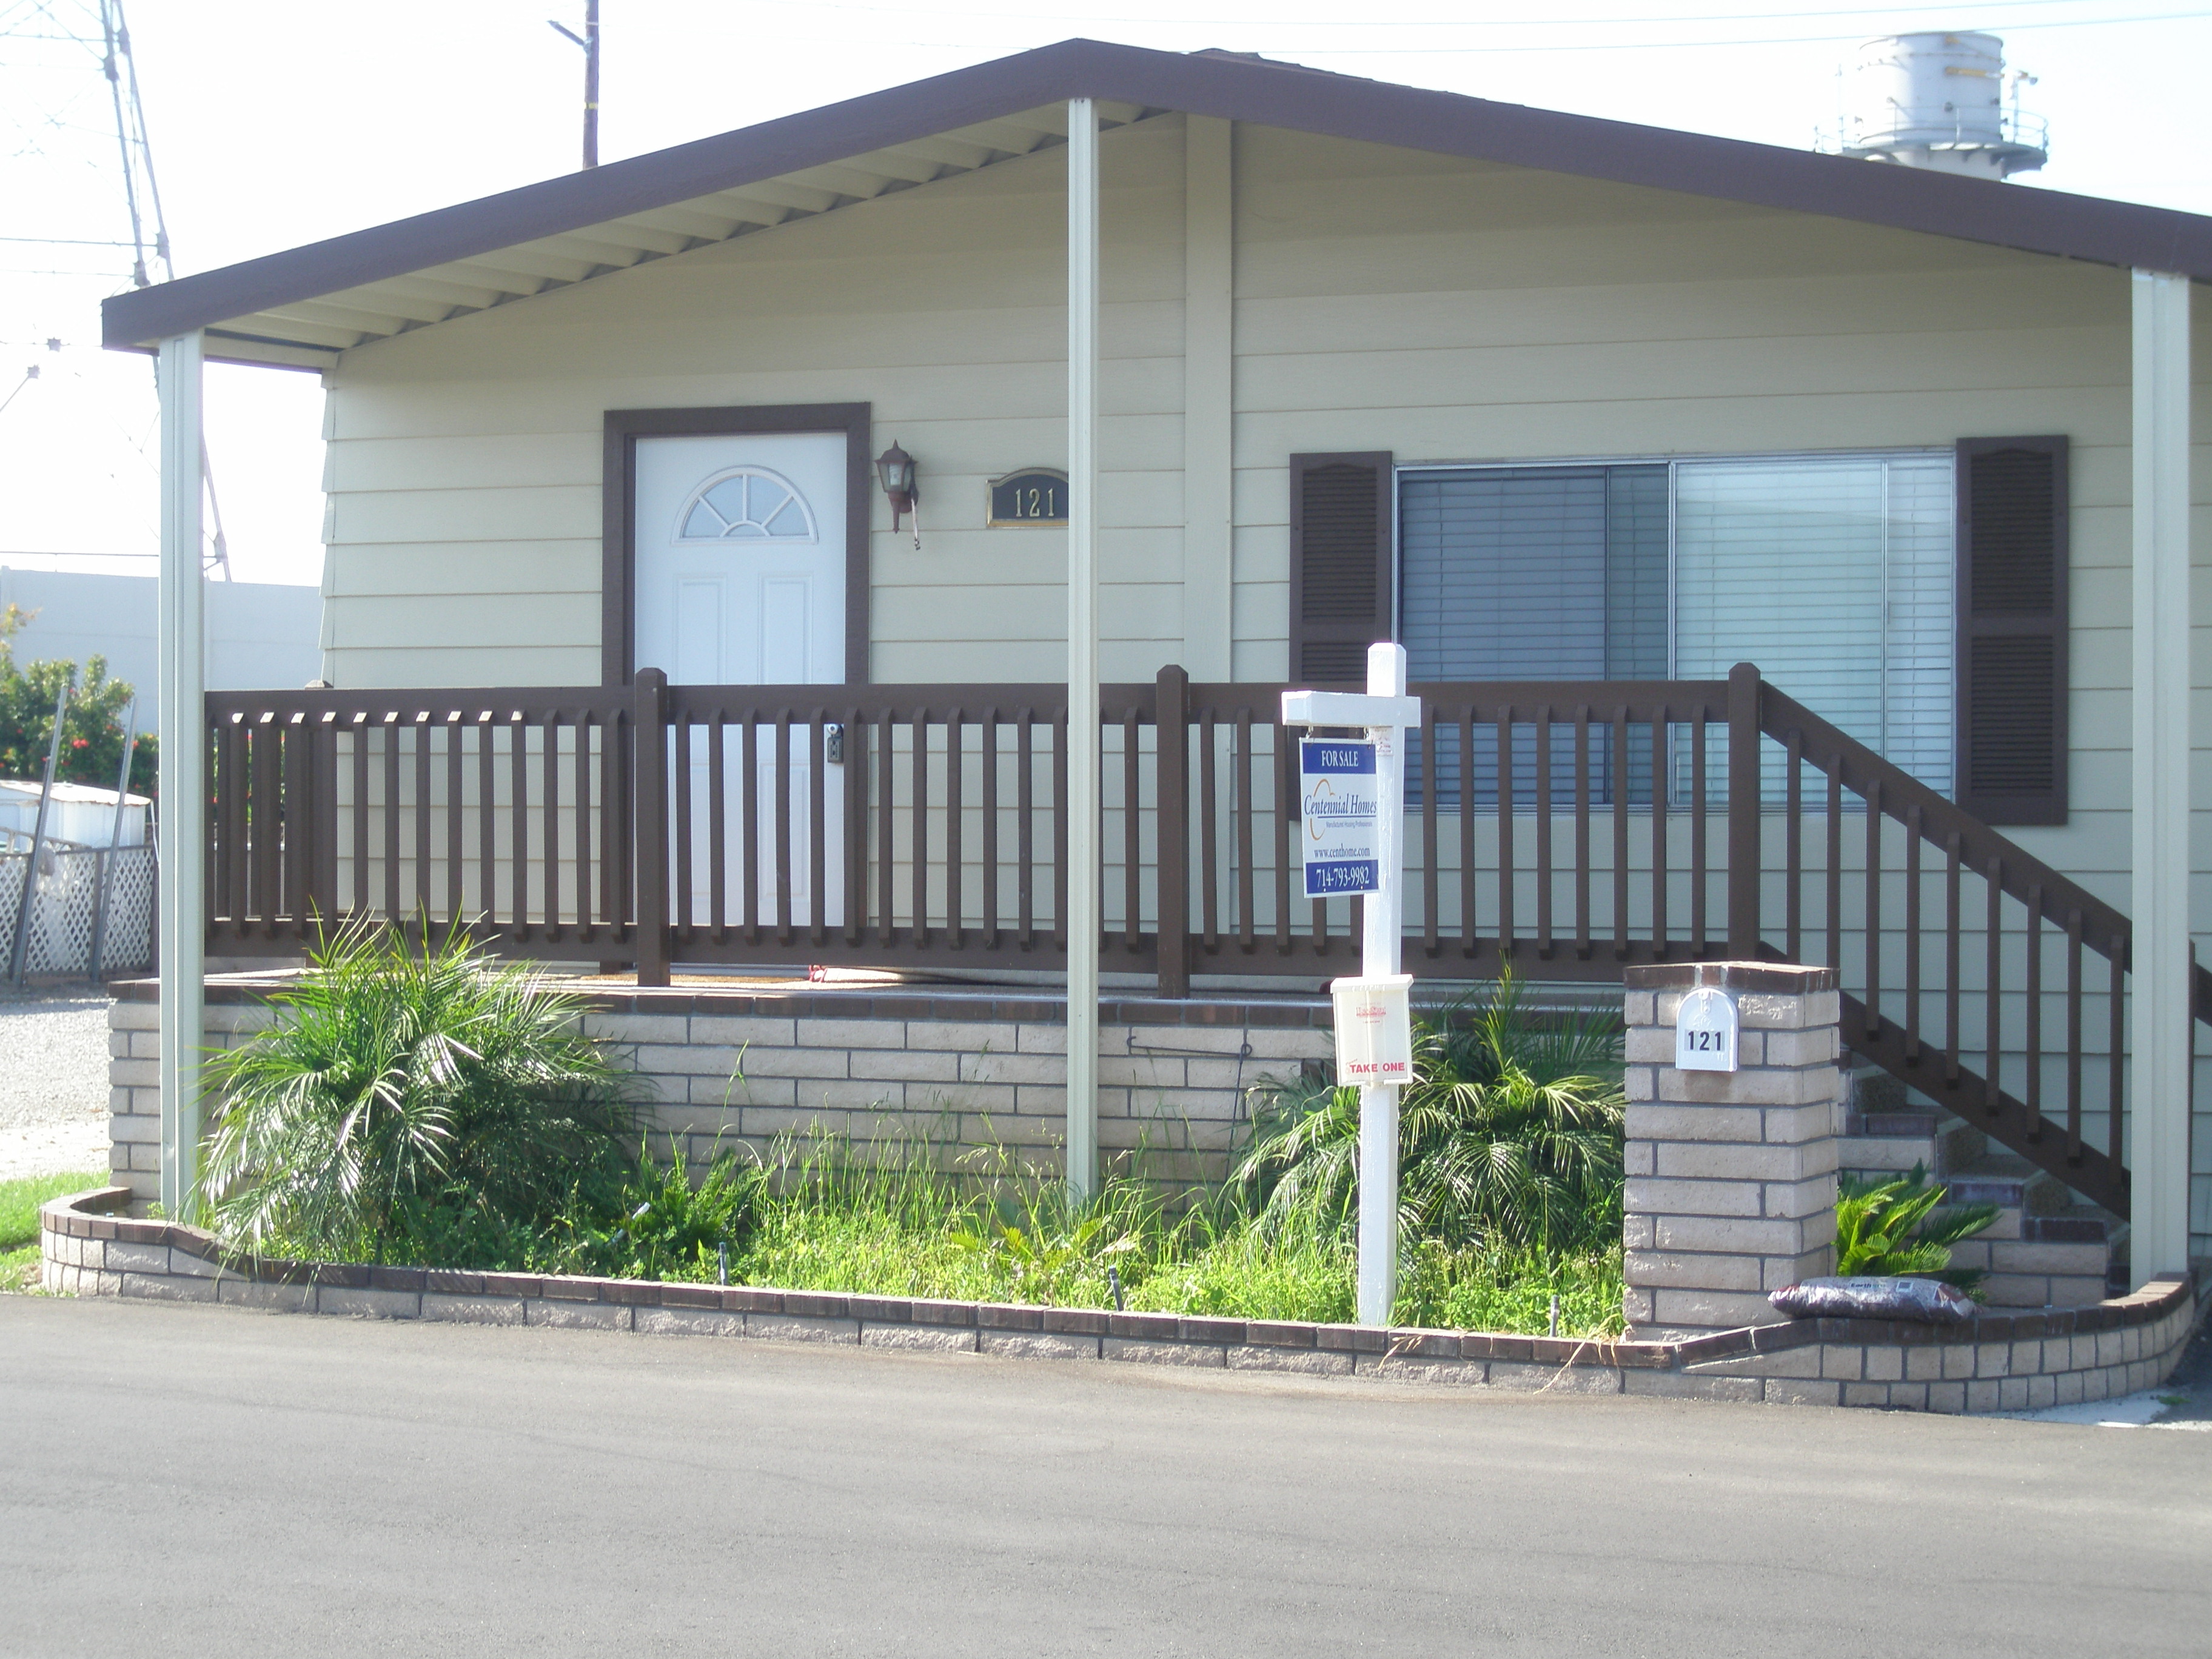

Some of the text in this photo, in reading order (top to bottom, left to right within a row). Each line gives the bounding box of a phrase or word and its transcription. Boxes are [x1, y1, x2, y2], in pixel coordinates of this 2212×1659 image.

[1016, 488, 1054, 517] 121
[1321, 750, 1359, 767] FOR SALE
[1304, 793, 1377, 816] Centennial Homes
[1314, 843, 1370, 859] www.centhome.com
[1316, 866, 1370, 888] 714-793-9982
[1688, 1031, 1721, 1051] 121
[1349, 1062, 1405, 1073] TAKE ONE
